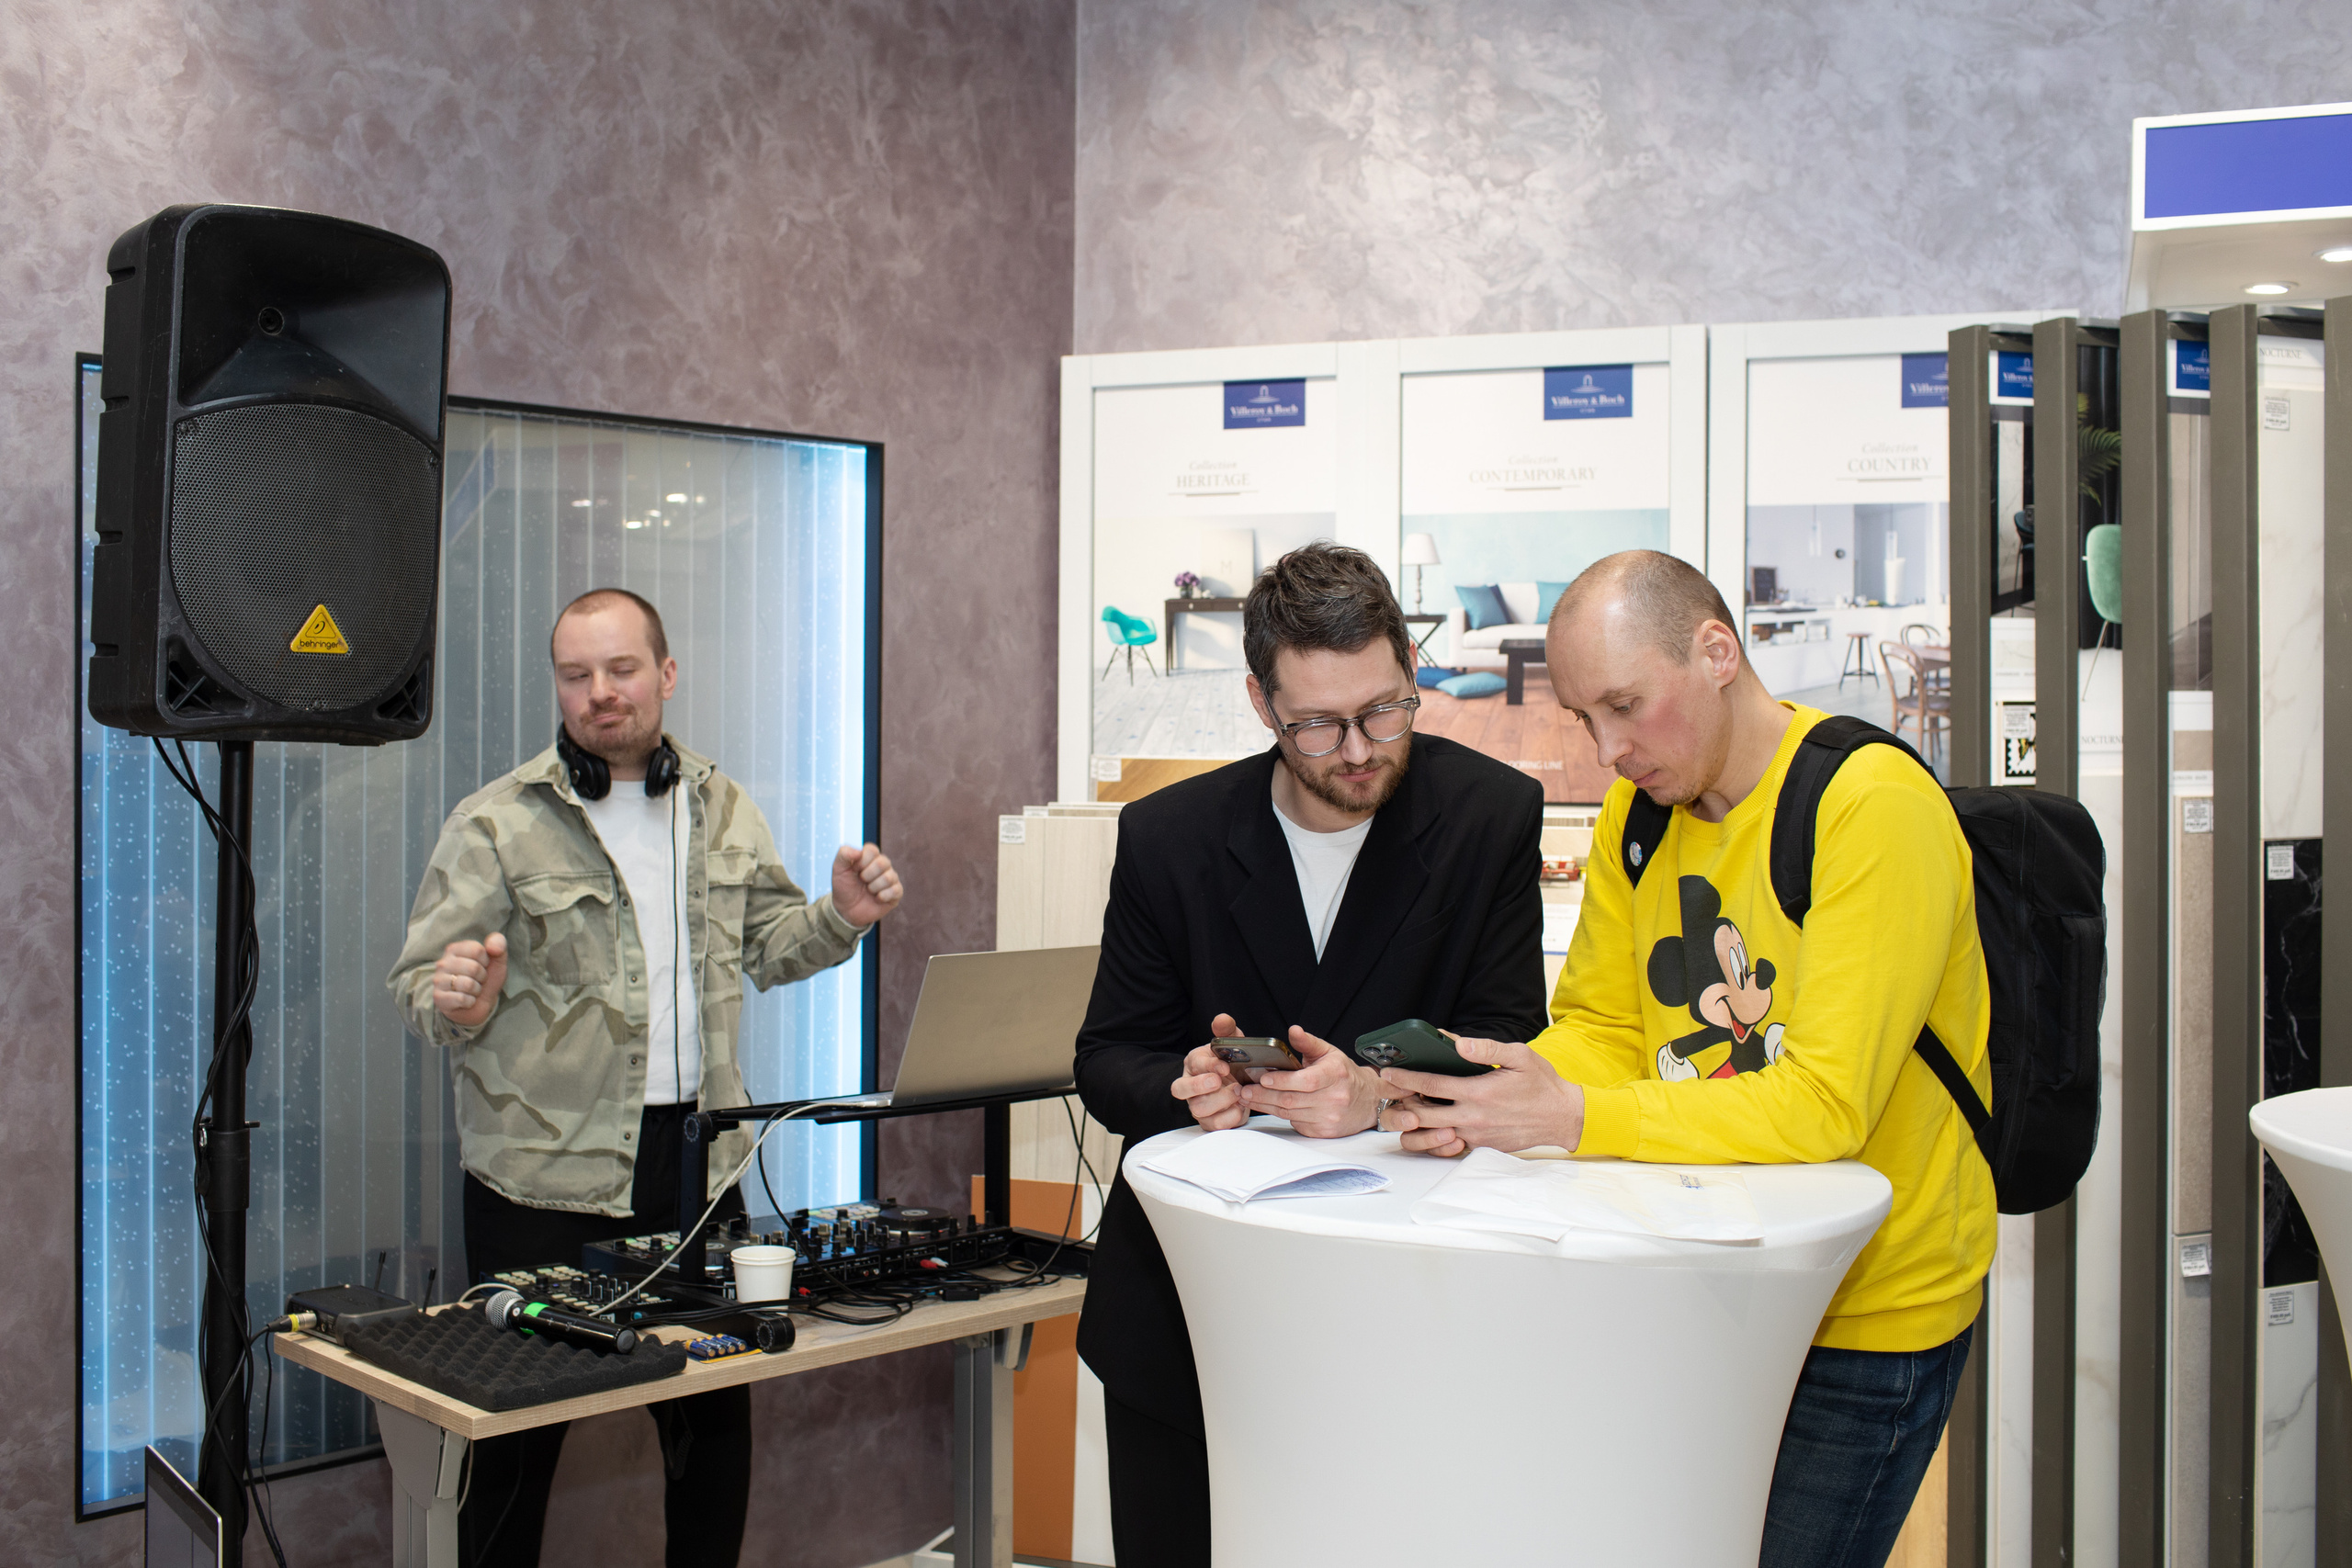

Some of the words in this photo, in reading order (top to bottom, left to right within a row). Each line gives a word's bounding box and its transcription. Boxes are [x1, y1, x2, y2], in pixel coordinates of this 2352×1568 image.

[1847, 457, 1932, 473] COUNTRY
[1176, 472, 1250, 489] HERITAGE
[1469, 467, 1598, 484] CONTEMPORARY
[300, 638, 339, 650] behringer
[1544, 761, 1564, 771] LINE
